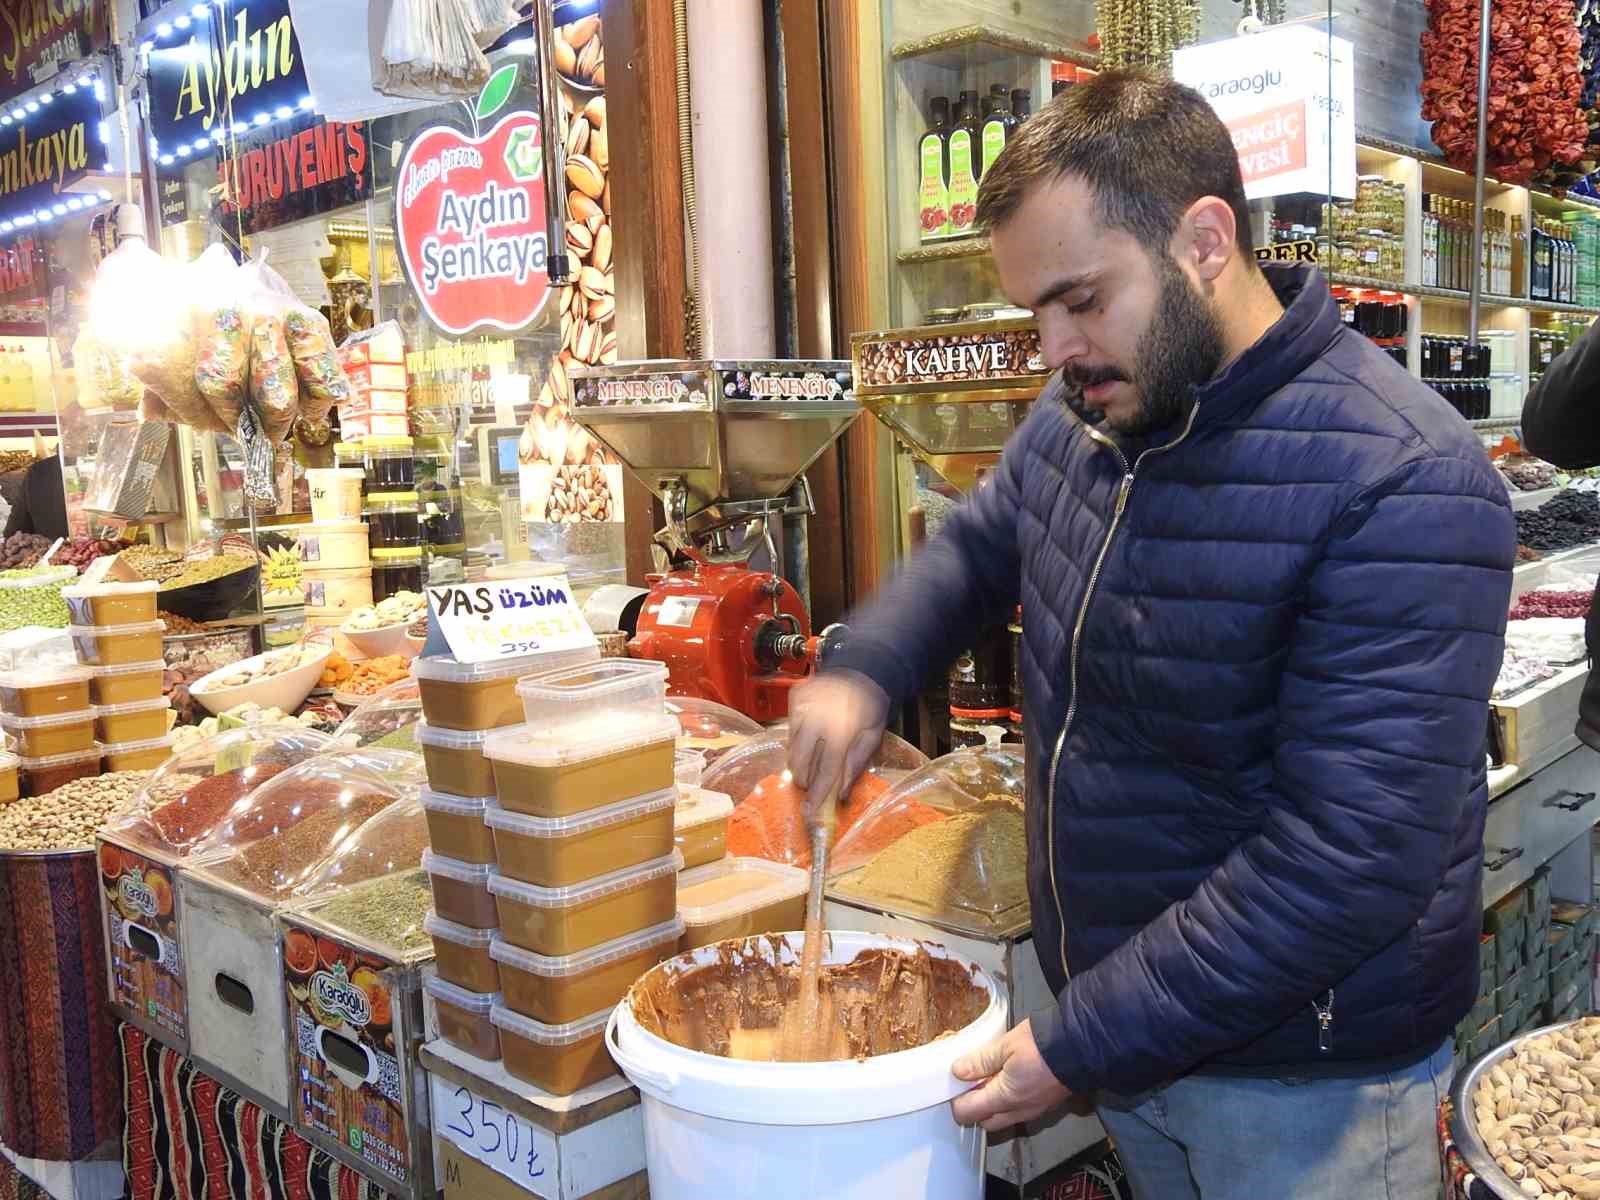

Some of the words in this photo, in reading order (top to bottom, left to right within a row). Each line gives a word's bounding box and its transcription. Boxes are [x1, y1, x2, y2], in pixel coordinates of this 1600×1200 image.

[175, 8, 294, 130] Aydın
[0, 122, 88, 194] nkaya
[1239, 142, 1291, 176] VESİ
[439, 184, 527, 236] Aydın
[423, 232, 547, 290] Şenkaya
[904, 343, 1008, 377] KAHVE
[430, 587, 494, 621] YAŞ
[499, 585, 568, 609] ÜZÜM
[319, 977, 365, 1015] Karaoğlu
